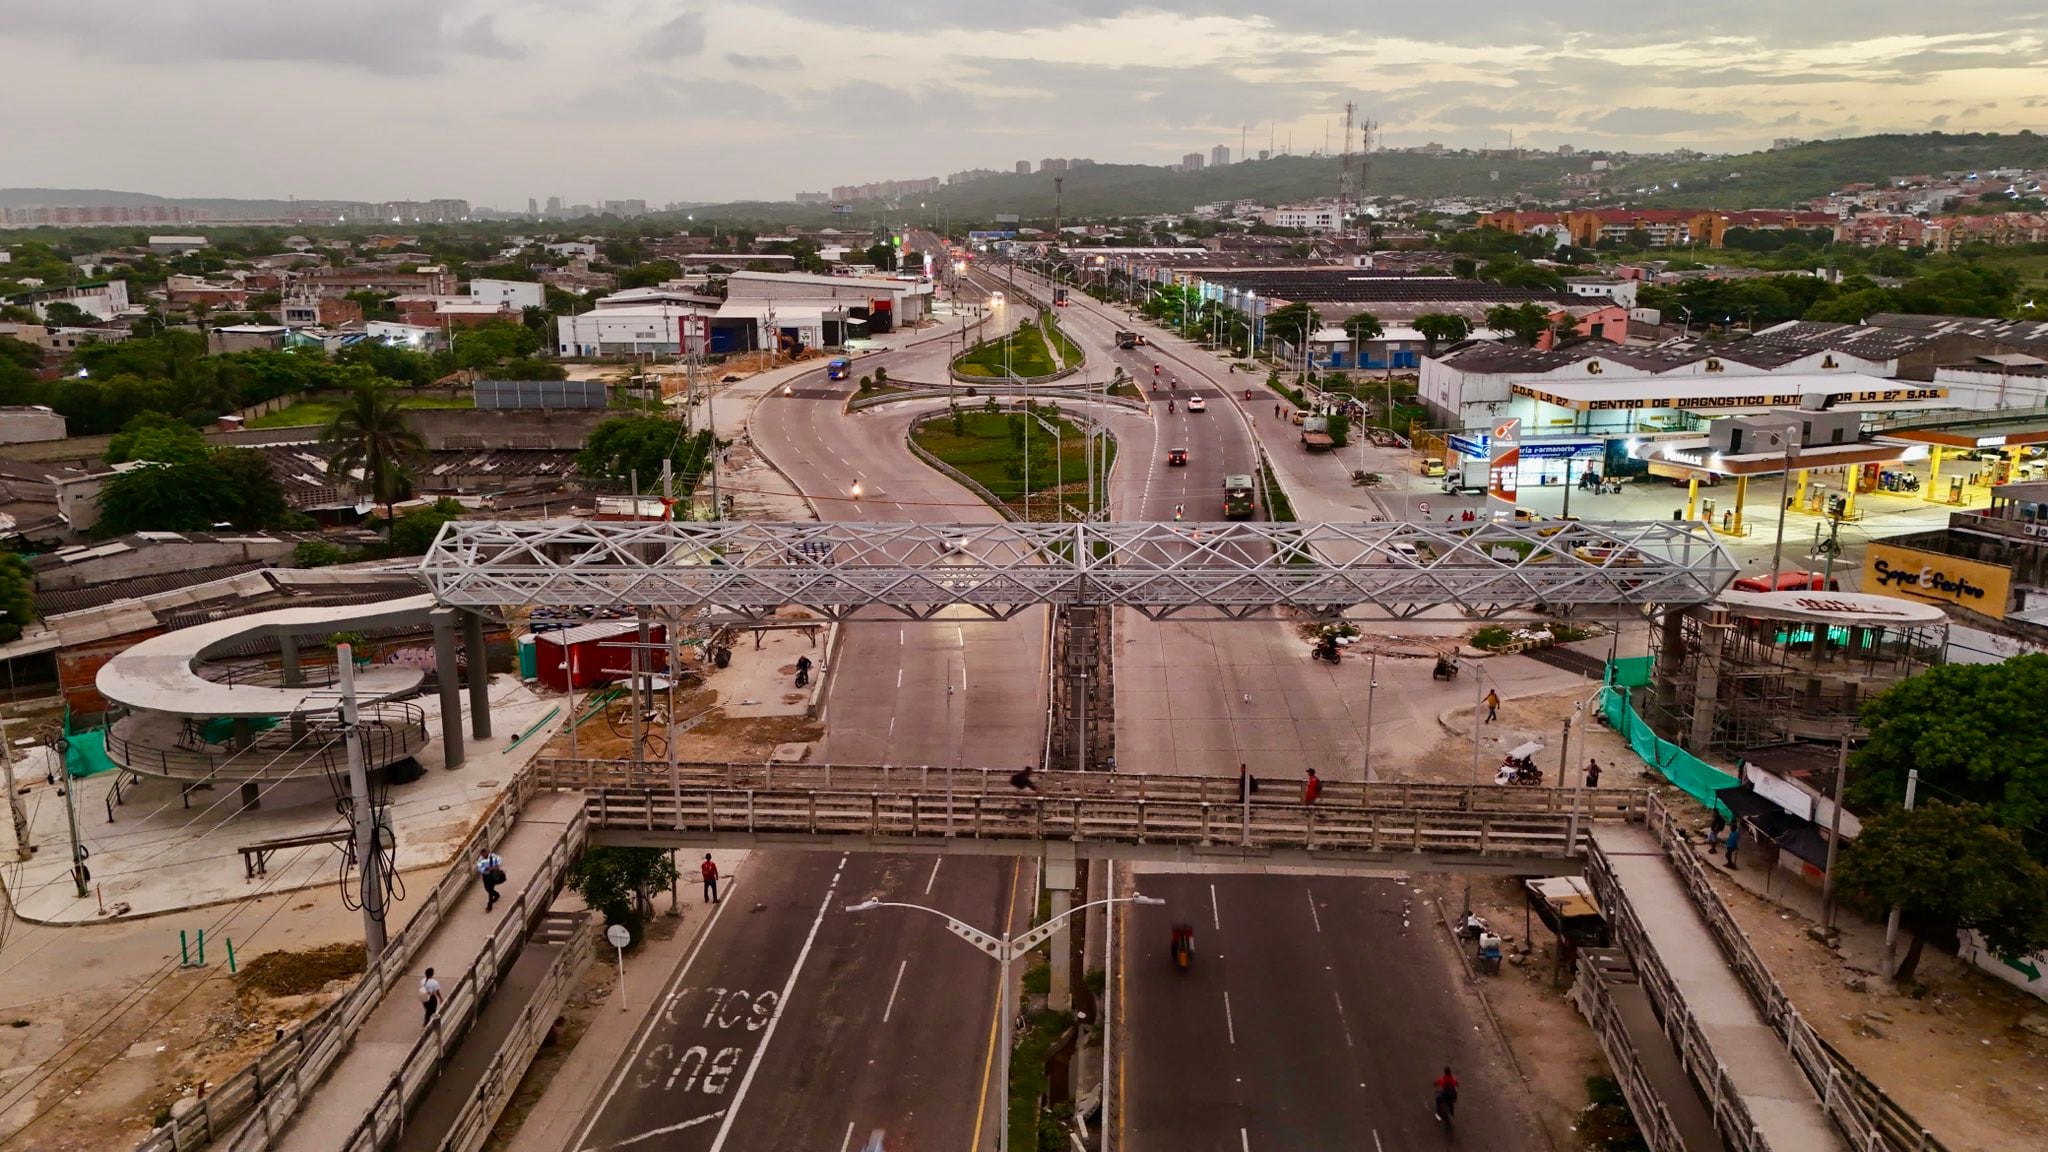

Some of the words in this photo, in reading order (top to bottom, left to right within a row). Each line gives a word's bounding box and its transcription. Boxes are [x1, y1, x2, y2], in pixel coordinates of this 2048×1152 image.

[1587, 359, 1603, 375] C.
[1705, 358, 1724, 373] D.
[1821, 354, 1839, 369] A.
[1540, 391, 1553, 401] LA
[1556, 397, 1569, 407] 27
[1589, 399, 1643, 410] CENTRO
[1652, 398, 1670, 408] DE
[1678, 395, 1765, 407] DIAGNOSTICO
[1860, 391, 1876, 401] LA
[1883, 391, 1901, 400] 27
[1907, 389, 1941, 399] S.A.S.
[636, 1043, 743, 1095] BUS
